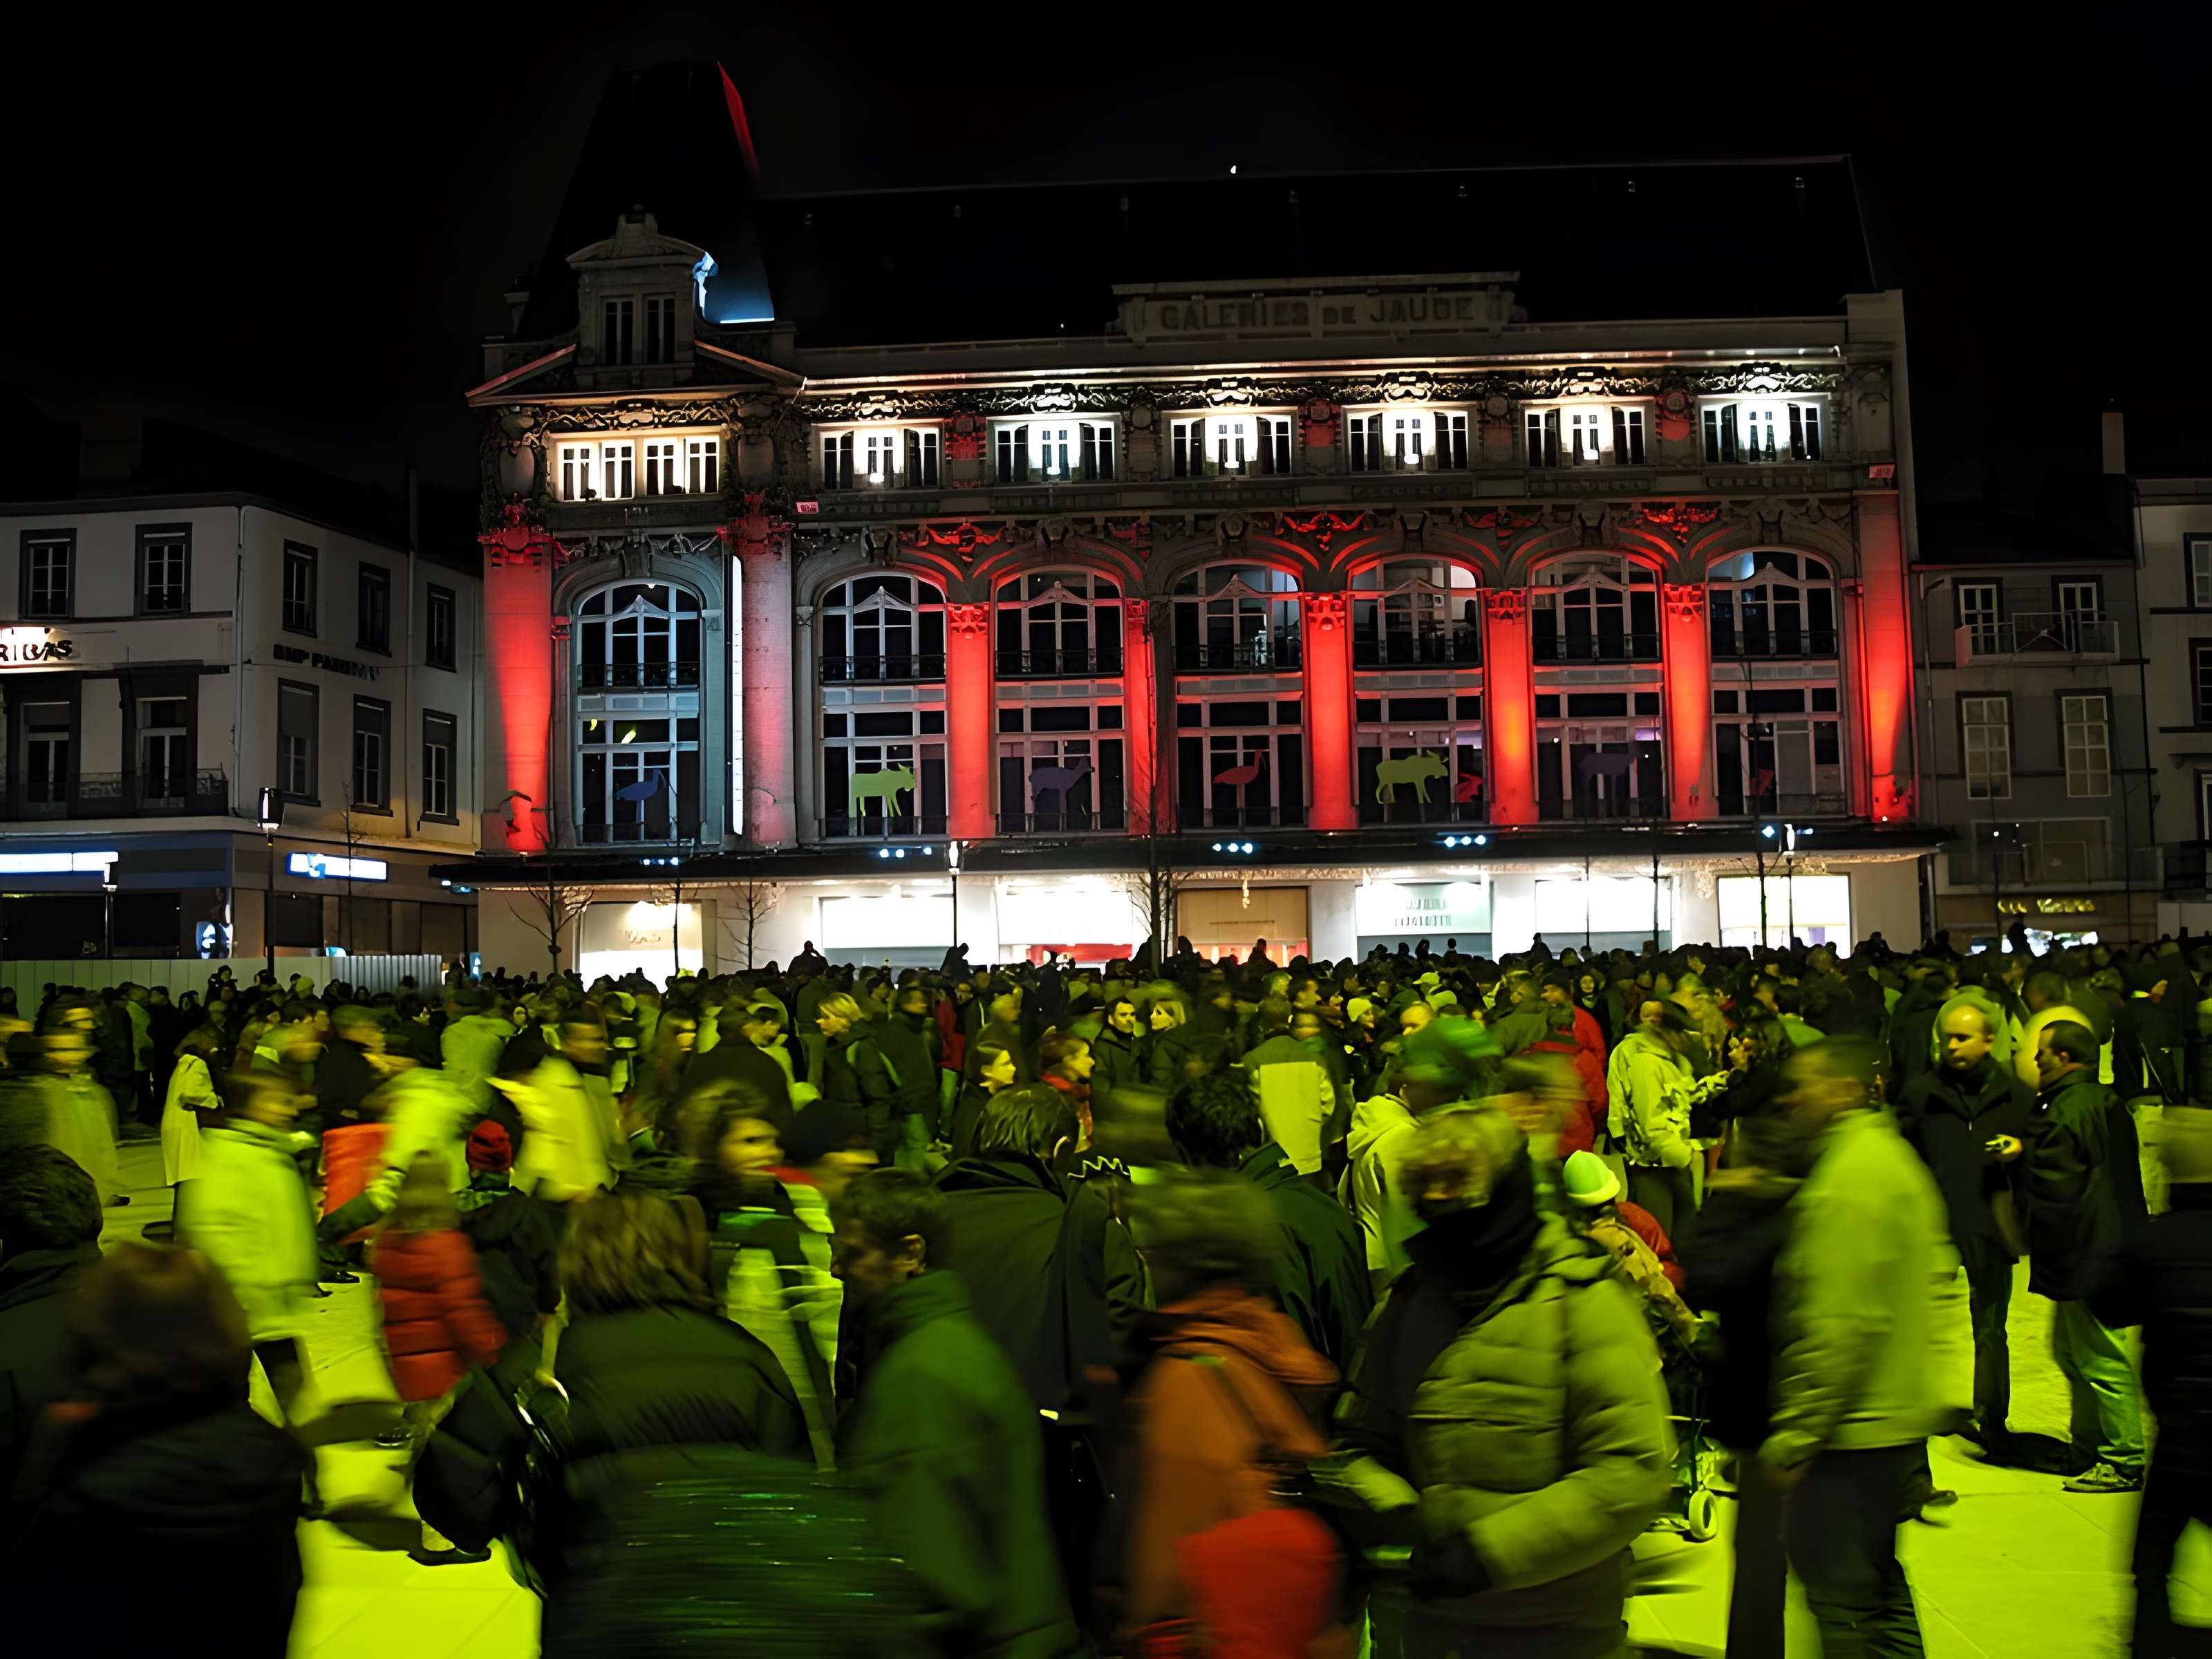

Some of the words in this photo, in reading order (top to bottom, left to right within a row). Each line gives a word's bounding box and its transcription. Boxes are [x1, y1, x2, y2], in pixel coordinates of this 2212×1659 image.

[1161, 301, 1309, 331] GALERIES
[1322, 306, 1356, 325] DE
[1369, 297, 1474, 324] JAUDE
